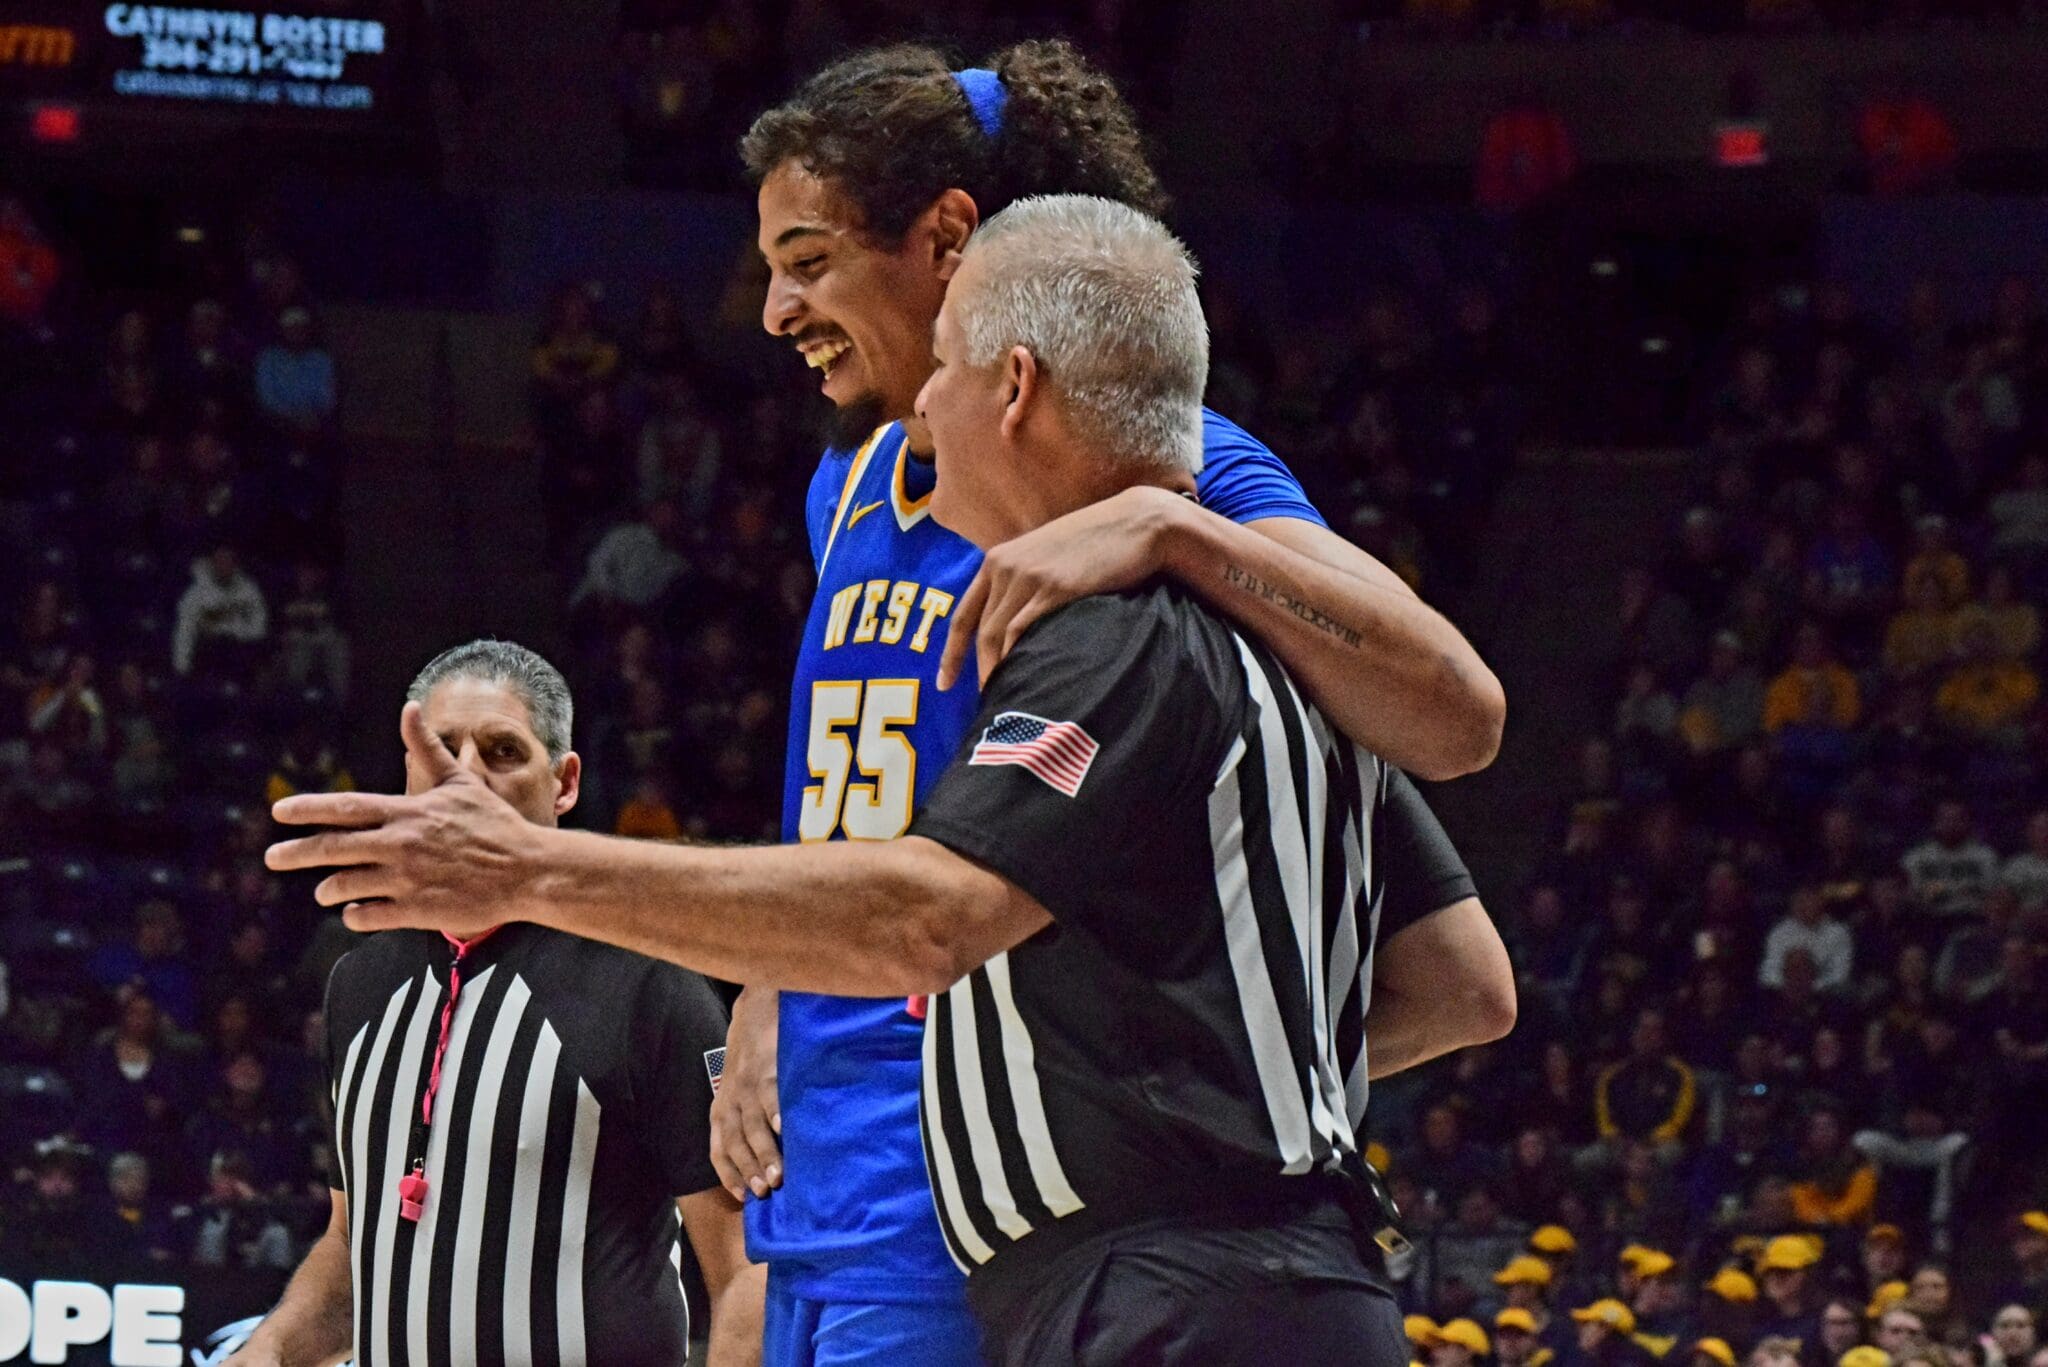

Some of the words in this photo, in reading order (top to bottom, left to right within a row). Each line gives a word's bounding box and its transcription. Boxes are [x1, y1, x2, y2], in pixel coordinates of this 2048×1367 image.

[105, 3, 257, 40] CATHRYN
[262, 14, 385, 53] BOSTER
[823, 579, 954, 653] WEST
[799, 678, 920, 842] 55
